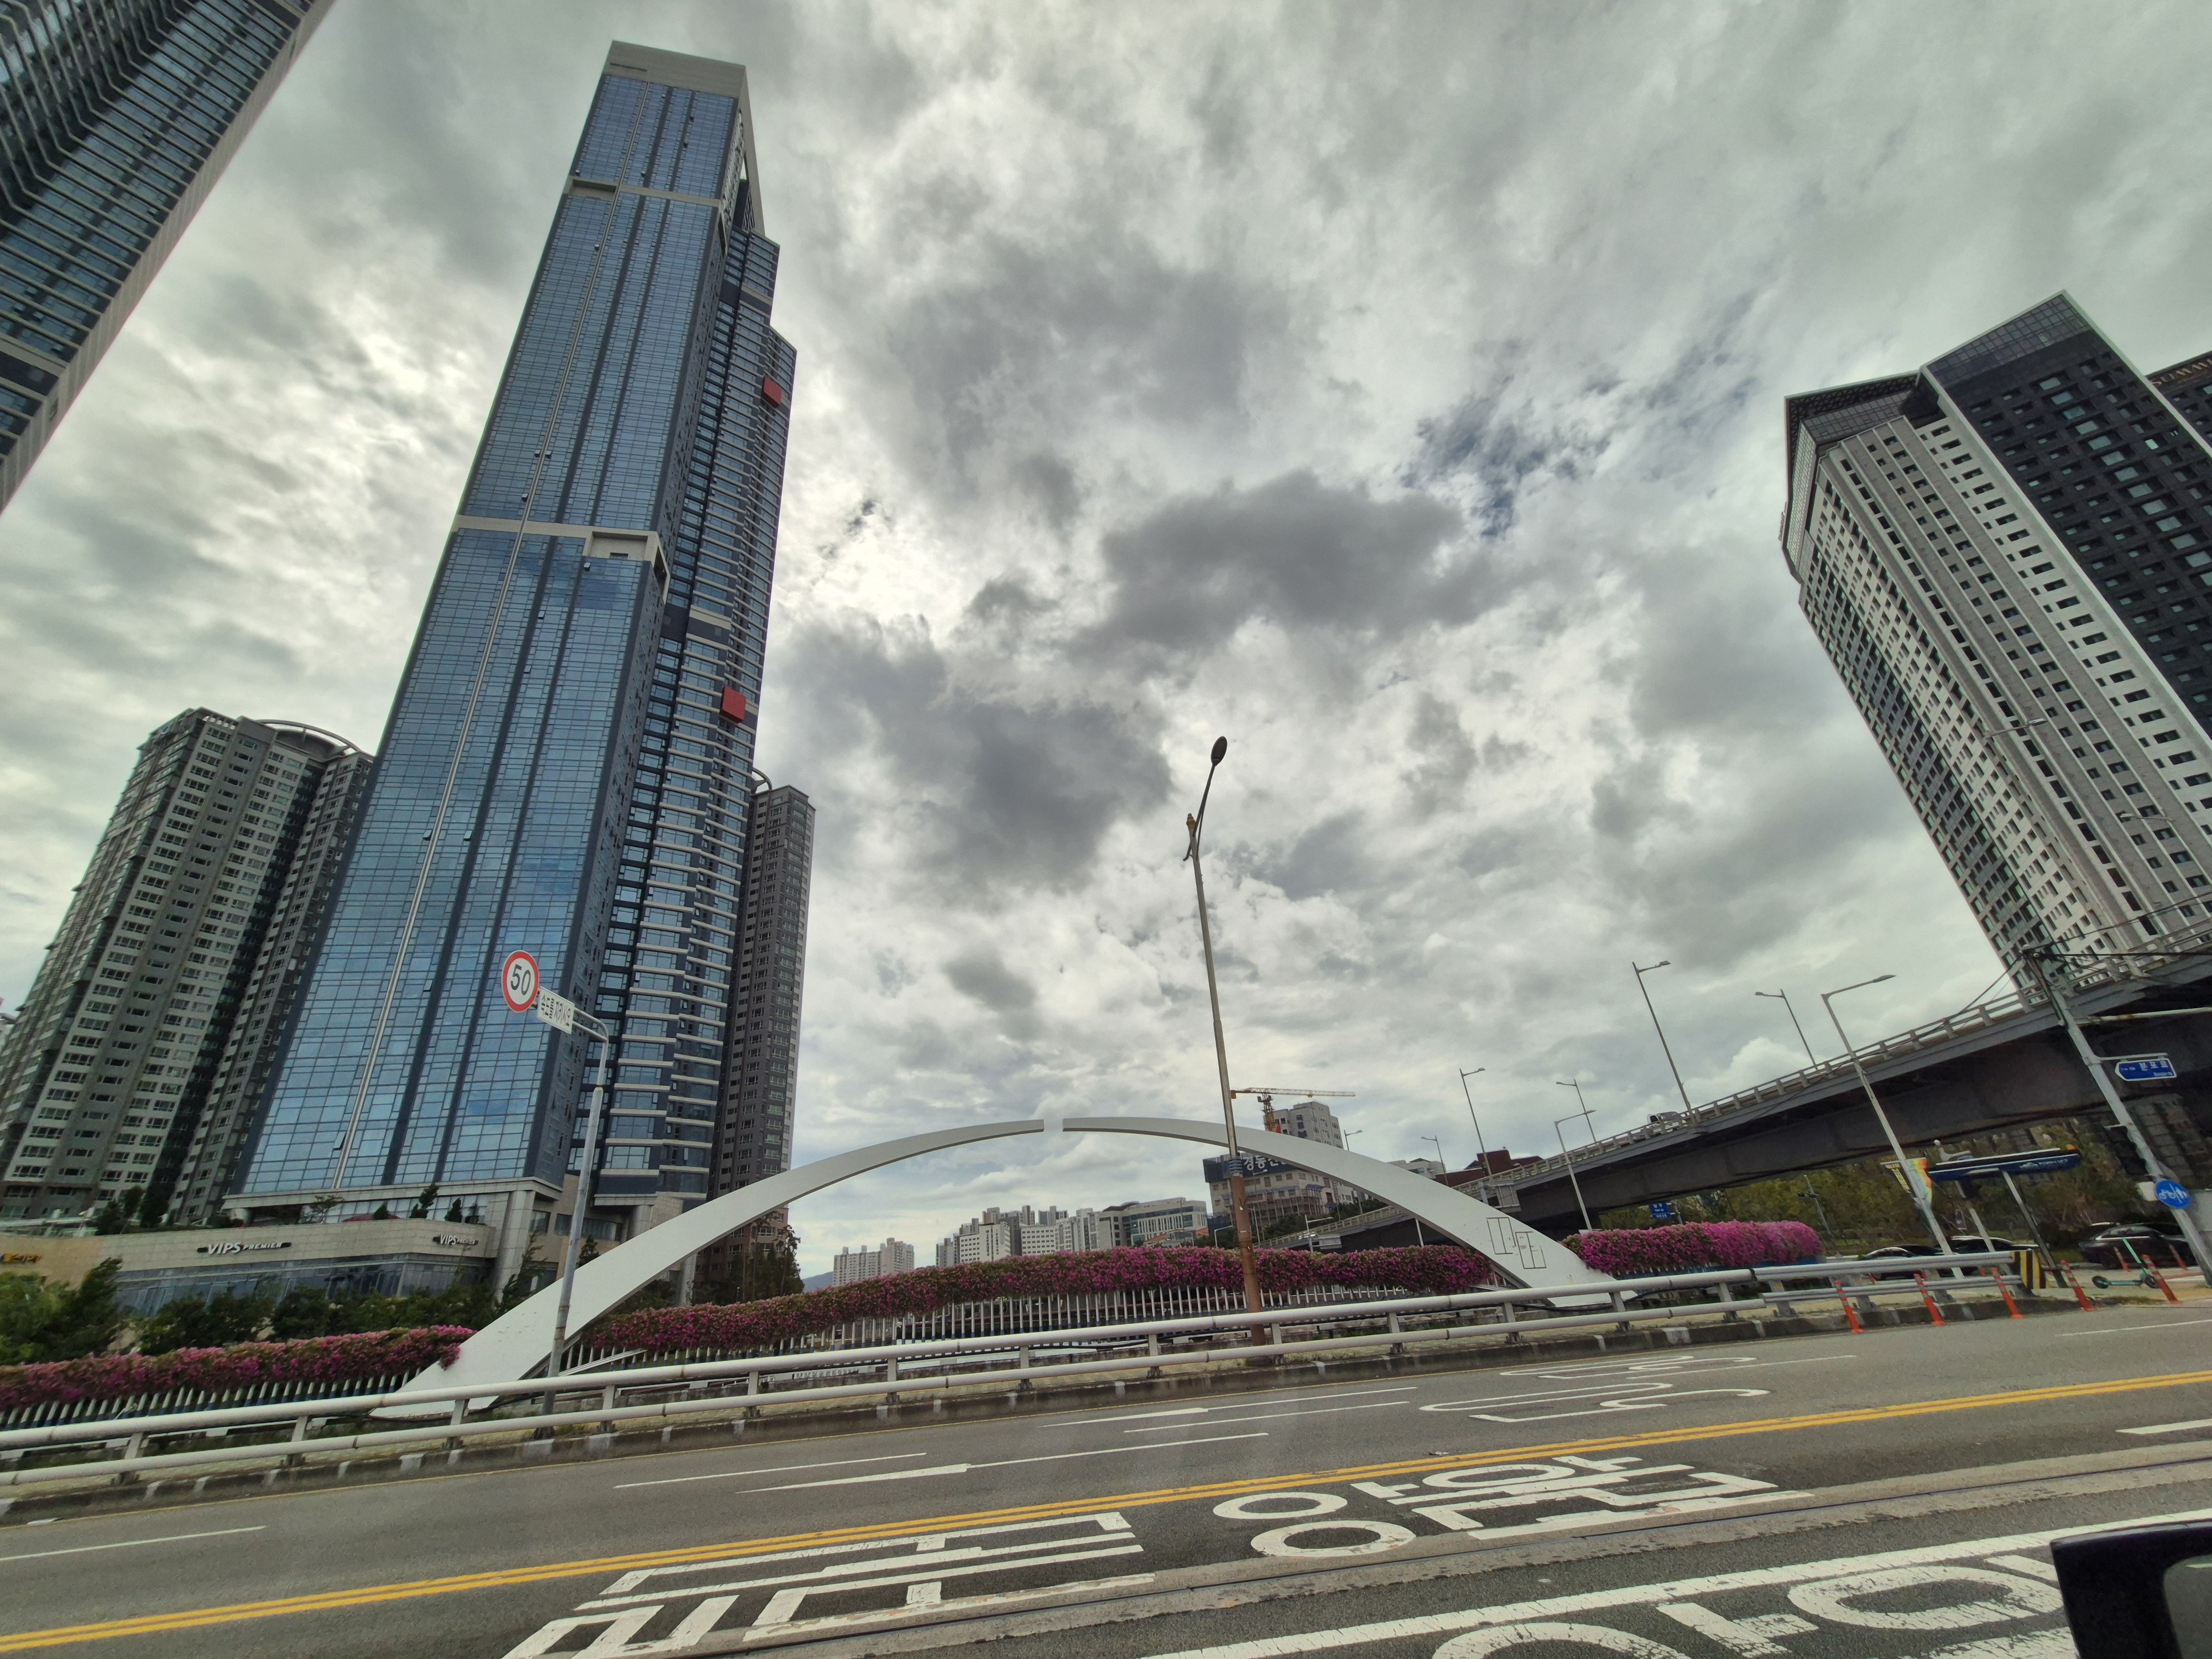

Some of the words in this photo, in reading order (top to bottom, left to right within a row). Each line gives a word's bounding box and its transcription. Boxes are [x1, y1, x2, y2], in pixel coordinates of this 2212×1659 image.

[510, 963, 531, 995] 50
[554, 1001, 571, 1027] 지키시오
[208, 1242, 241, 1255] VIPS
[243, 1242, 283, 1250] PREMIER
[440, 1233, 457, 1245] VIPS
